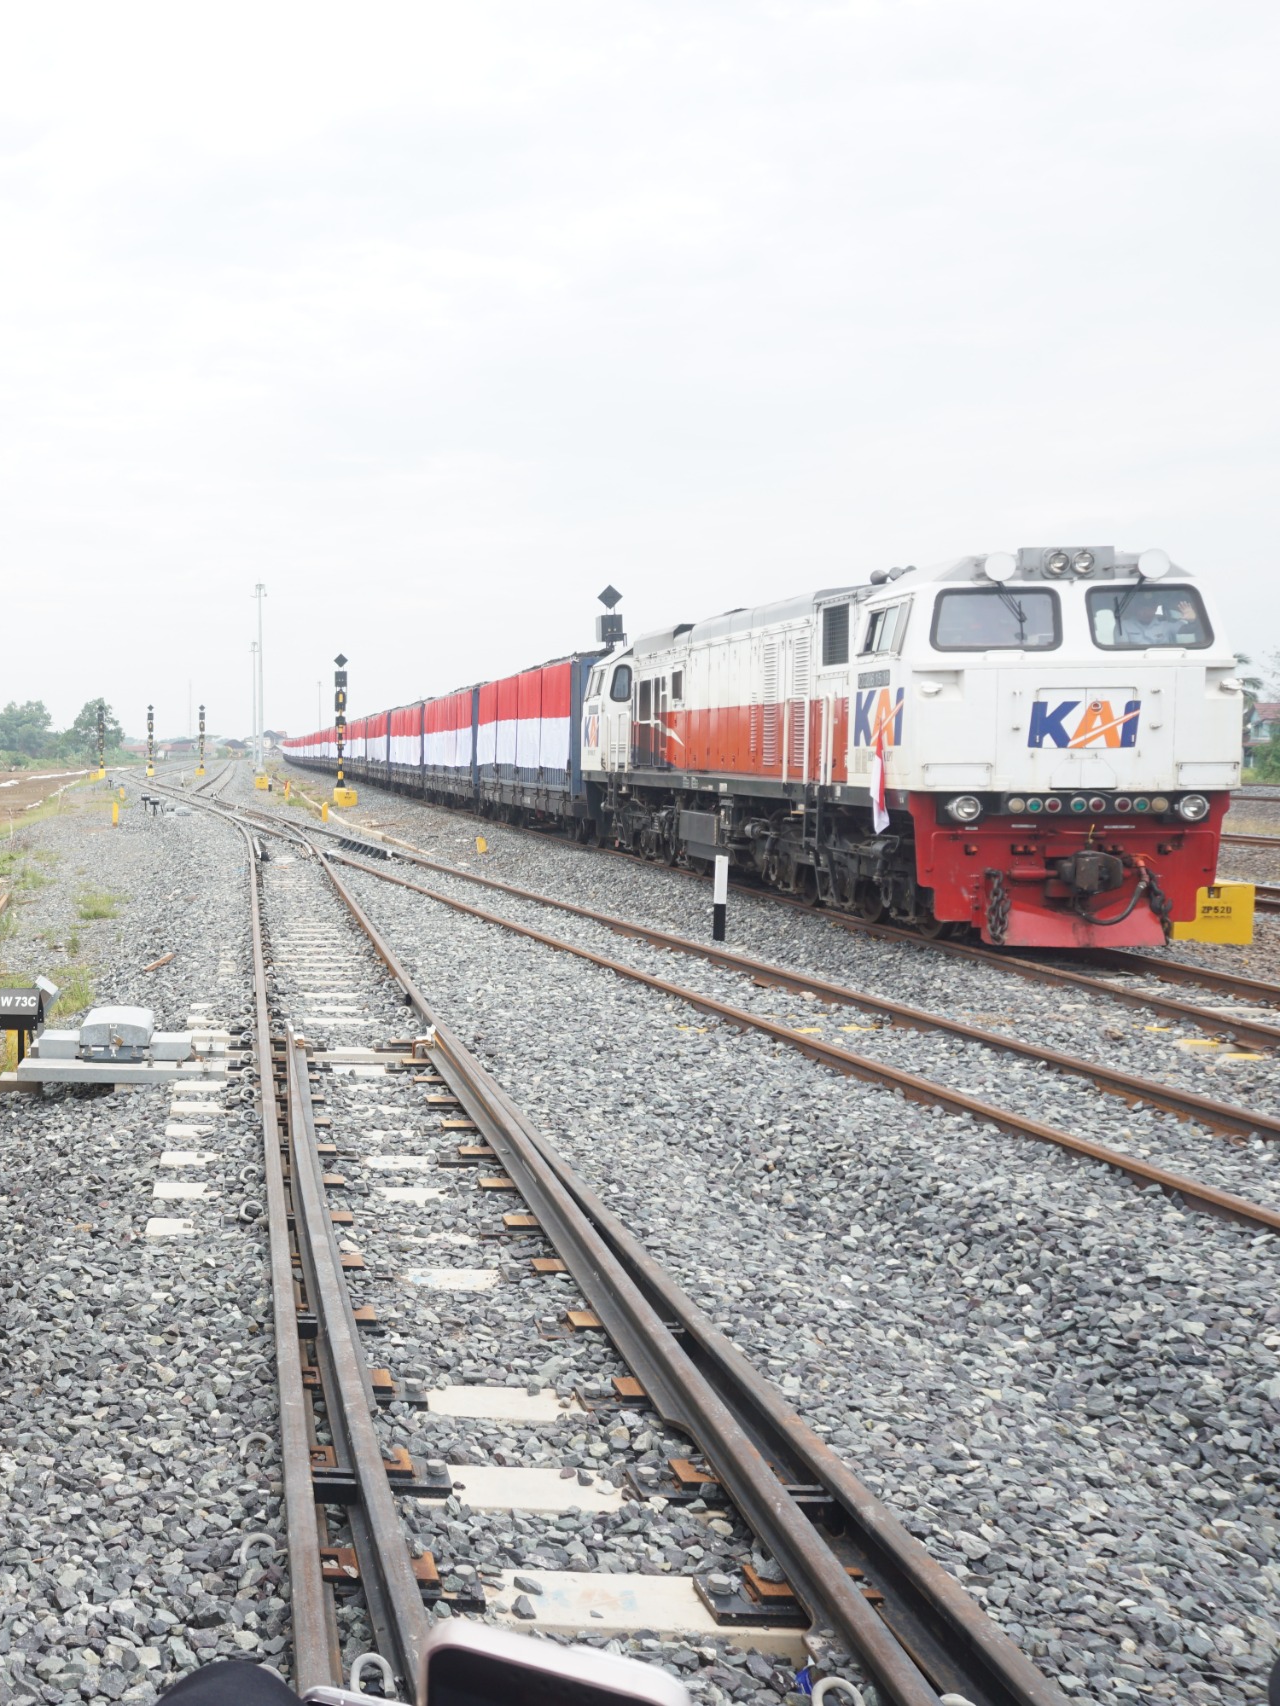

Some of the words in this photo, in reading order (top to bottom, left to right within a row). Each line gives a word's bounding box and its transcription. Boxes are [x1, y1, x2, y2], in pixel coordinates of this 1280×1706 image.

[584, 715, 599, 747] KAI
[854, 687, 904, 747] KAI
[1027, 700, 1141, 748] KAI
[1, 996, 13, 1007] W
[14, 996, 37, 1007] 73C
